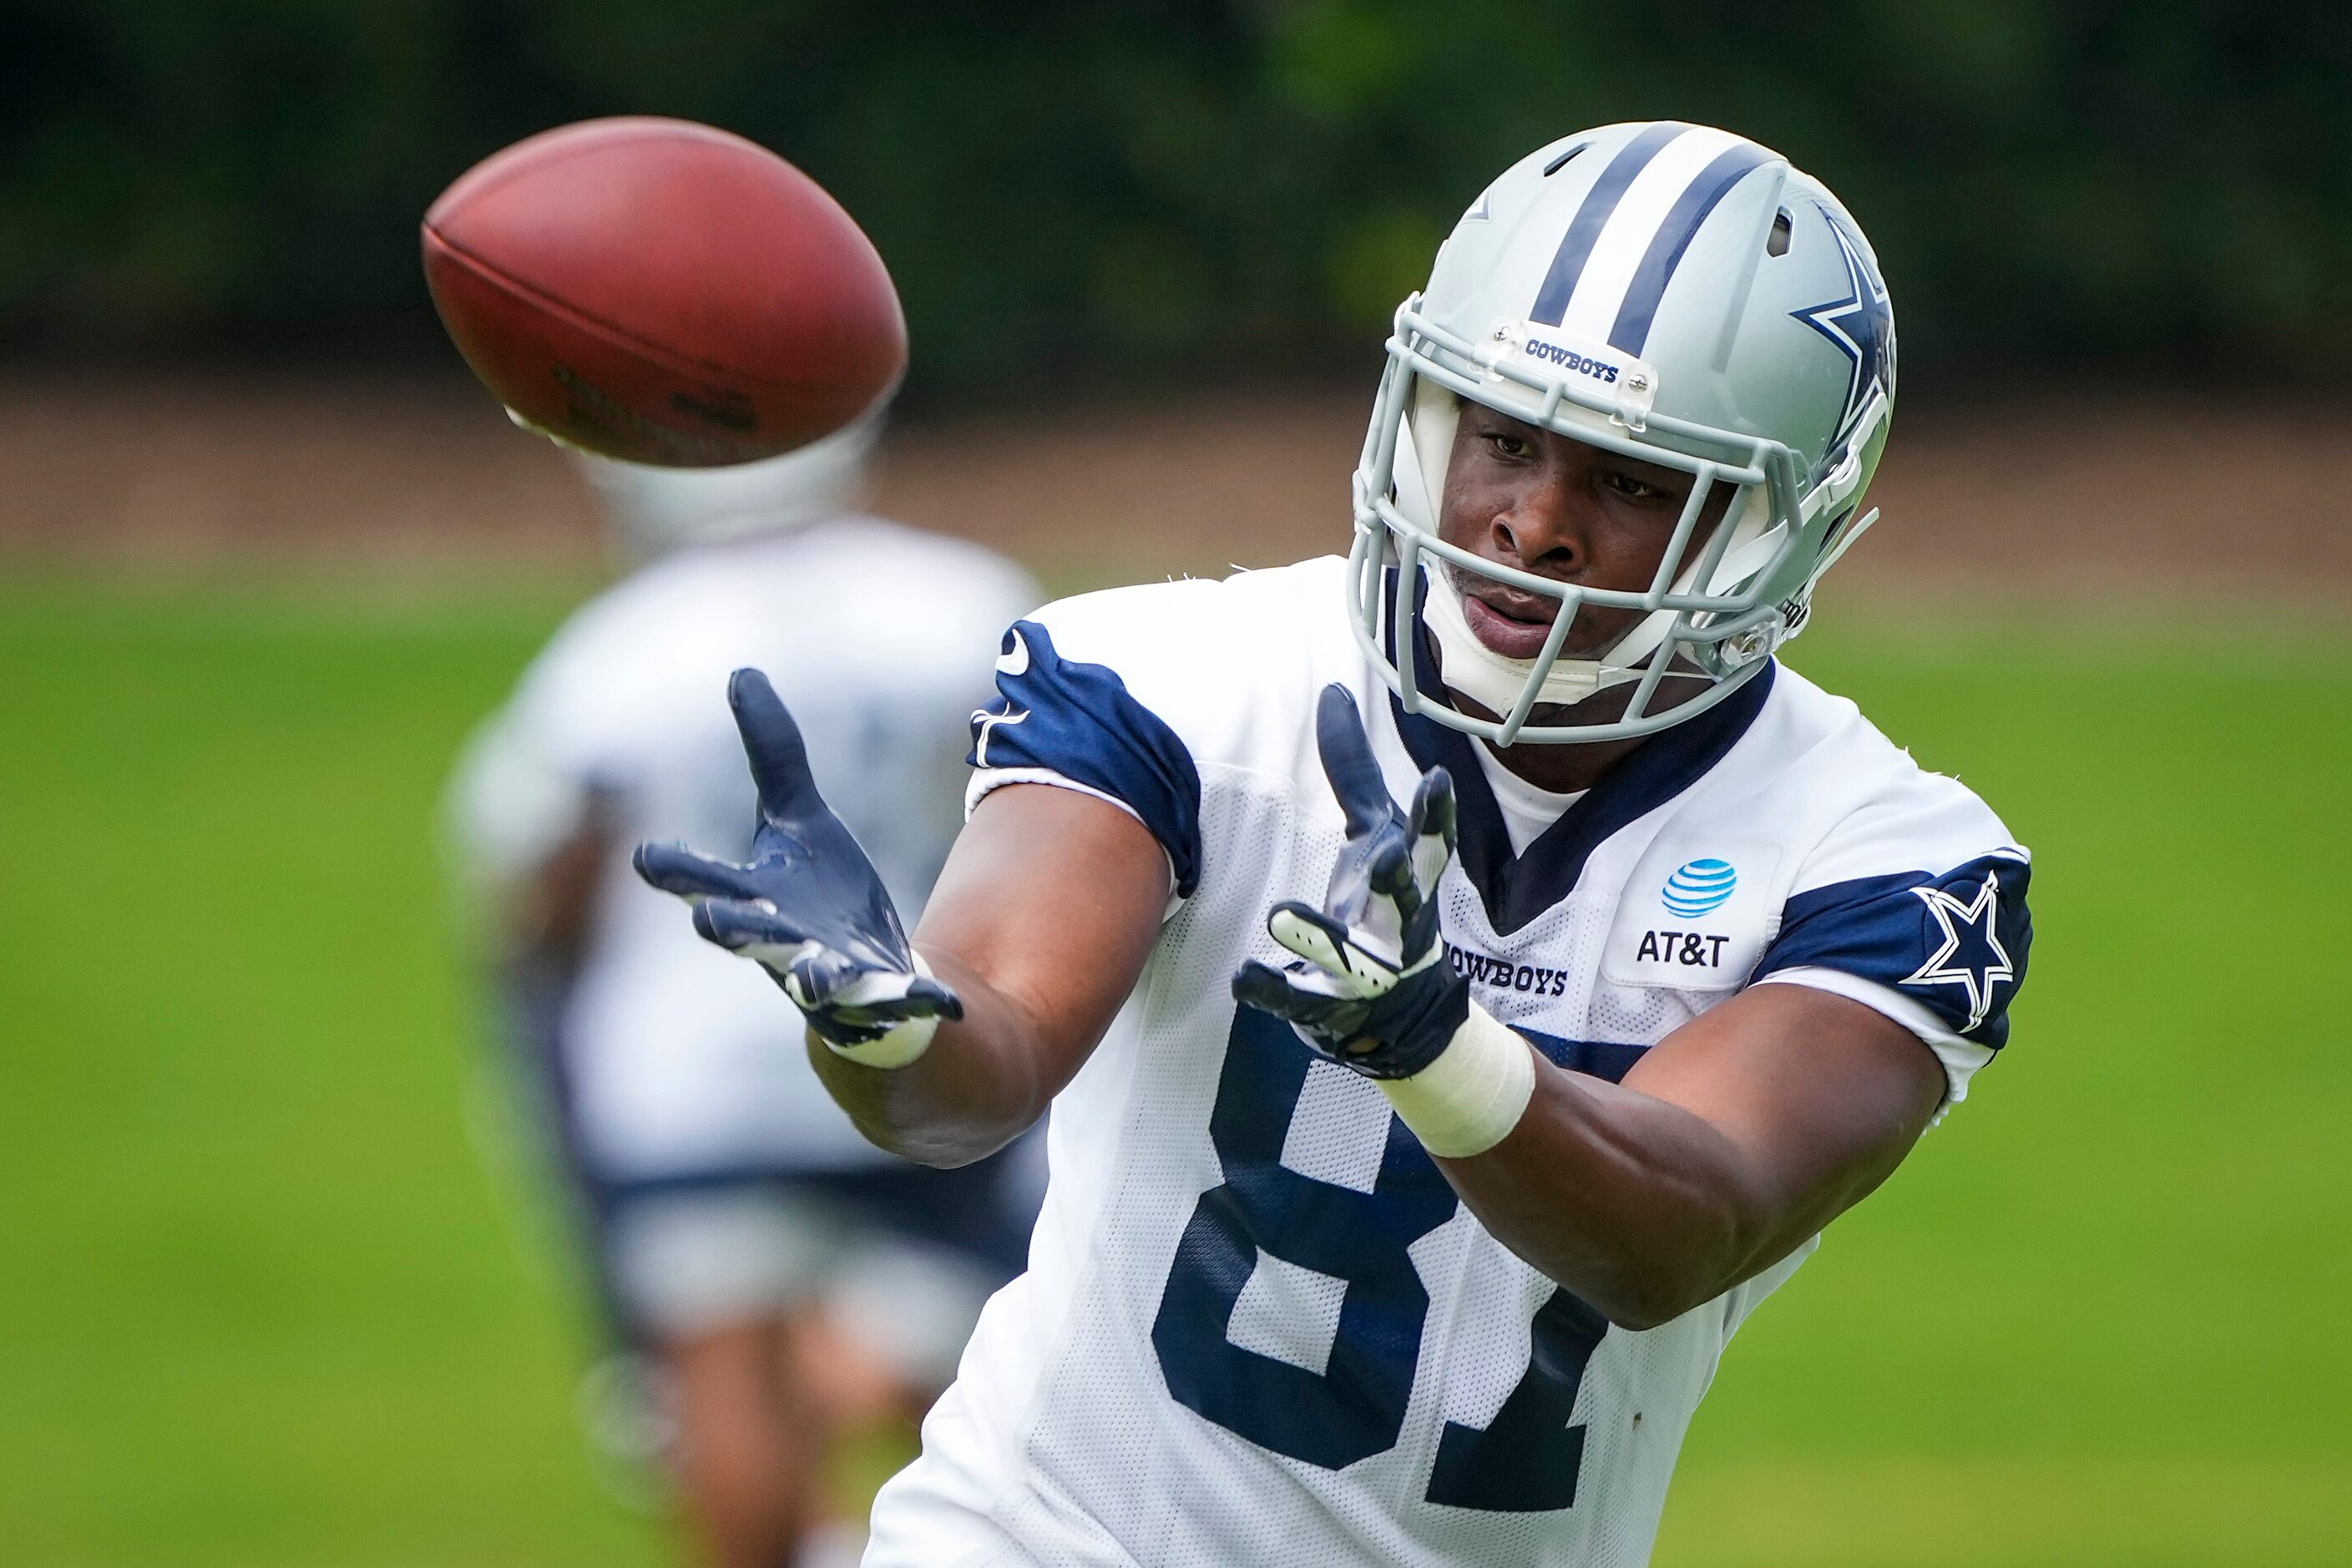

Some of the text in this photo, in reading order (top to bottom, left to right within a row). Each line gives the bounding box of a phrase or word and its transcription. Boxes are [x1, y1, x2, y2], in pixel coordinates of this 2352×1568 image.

[1525, 339, 1619, 383] COWBOYS
[1444, 942, 1568, 996] OWBOYS
[1636, 930, 1730, 968] AT&T
